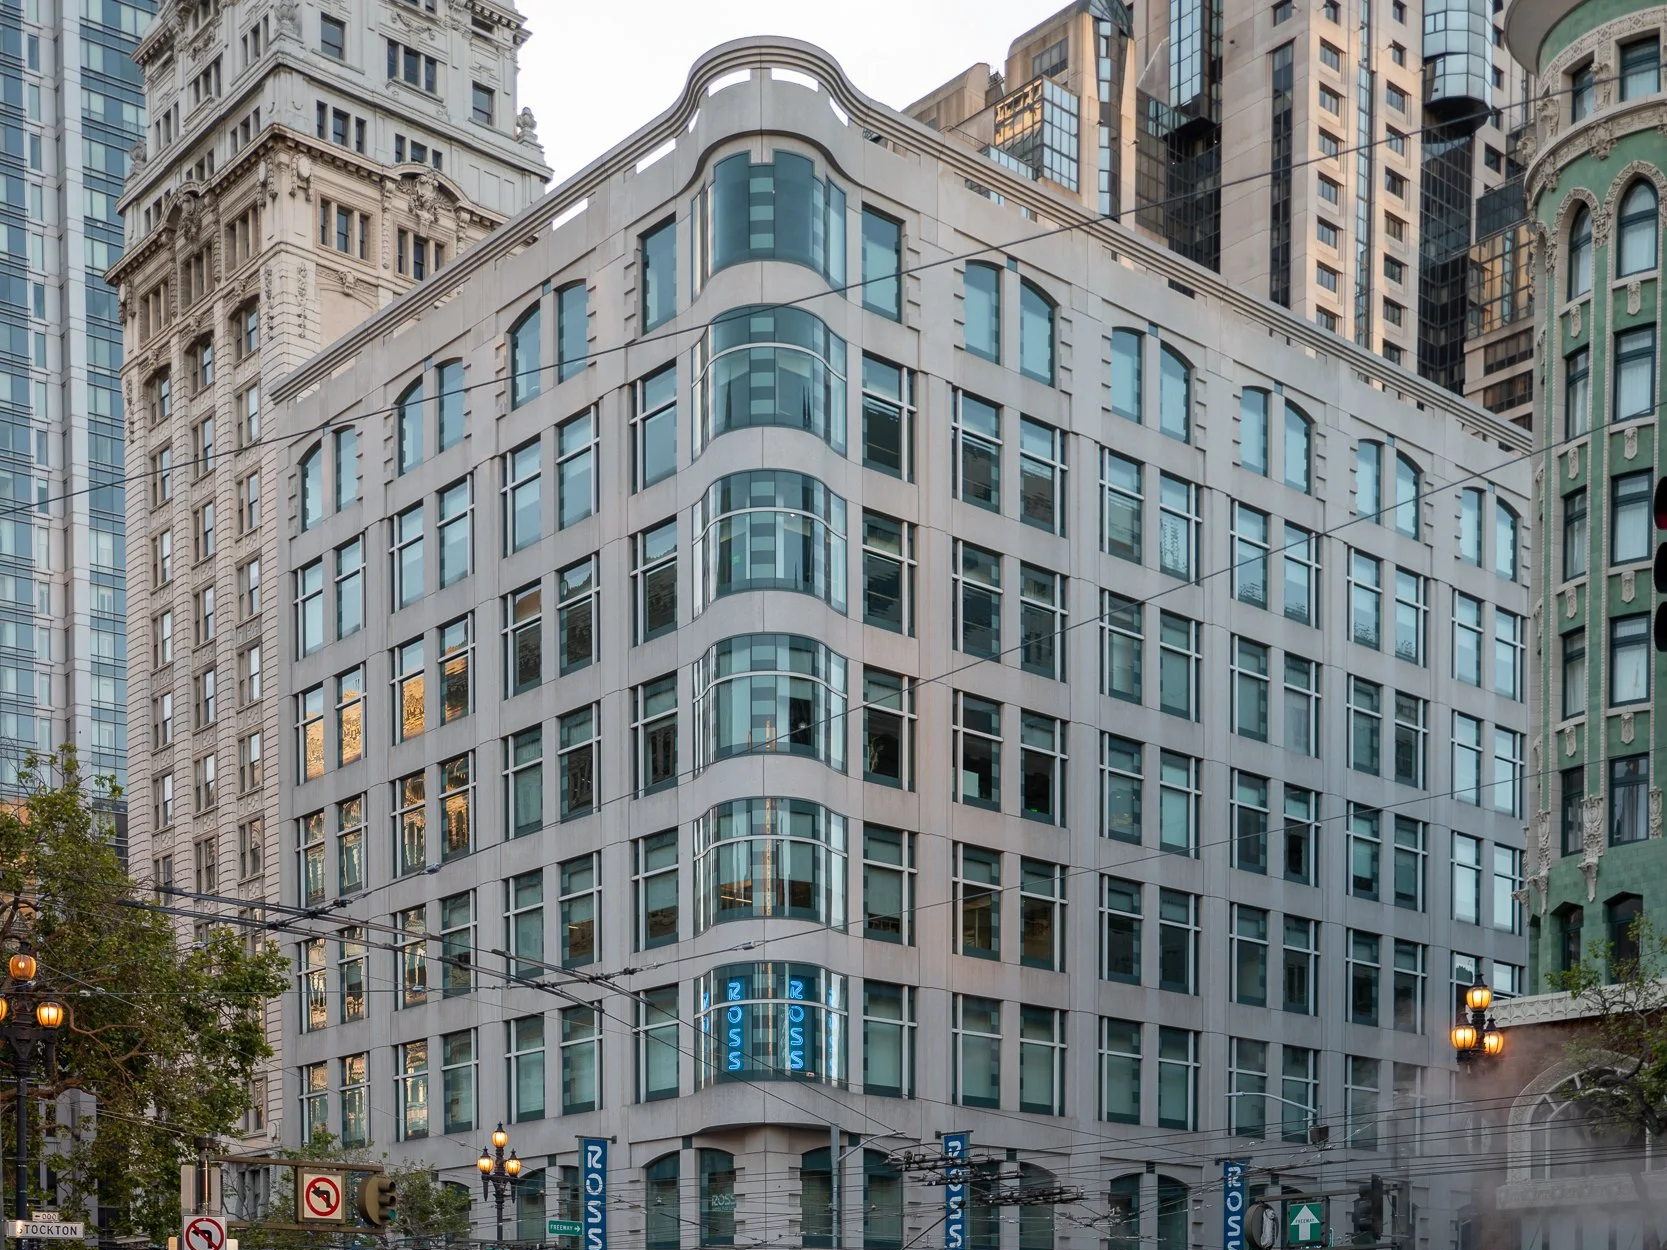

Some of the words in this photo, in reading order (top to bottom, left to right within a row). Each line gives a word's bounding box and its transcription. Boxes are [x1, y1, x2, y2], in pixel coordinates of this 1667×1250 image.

[727, 981, 743, 1071] ROSS
[789, 980, 805, 1070] ROSS
[549, 1223, 574, 1231] FREEWAY
[586, 1145, 603, 1250] ROSS
[711, 1193, 736, 1206] ROSS
[949, 1140, 963, 1249] ROSS
